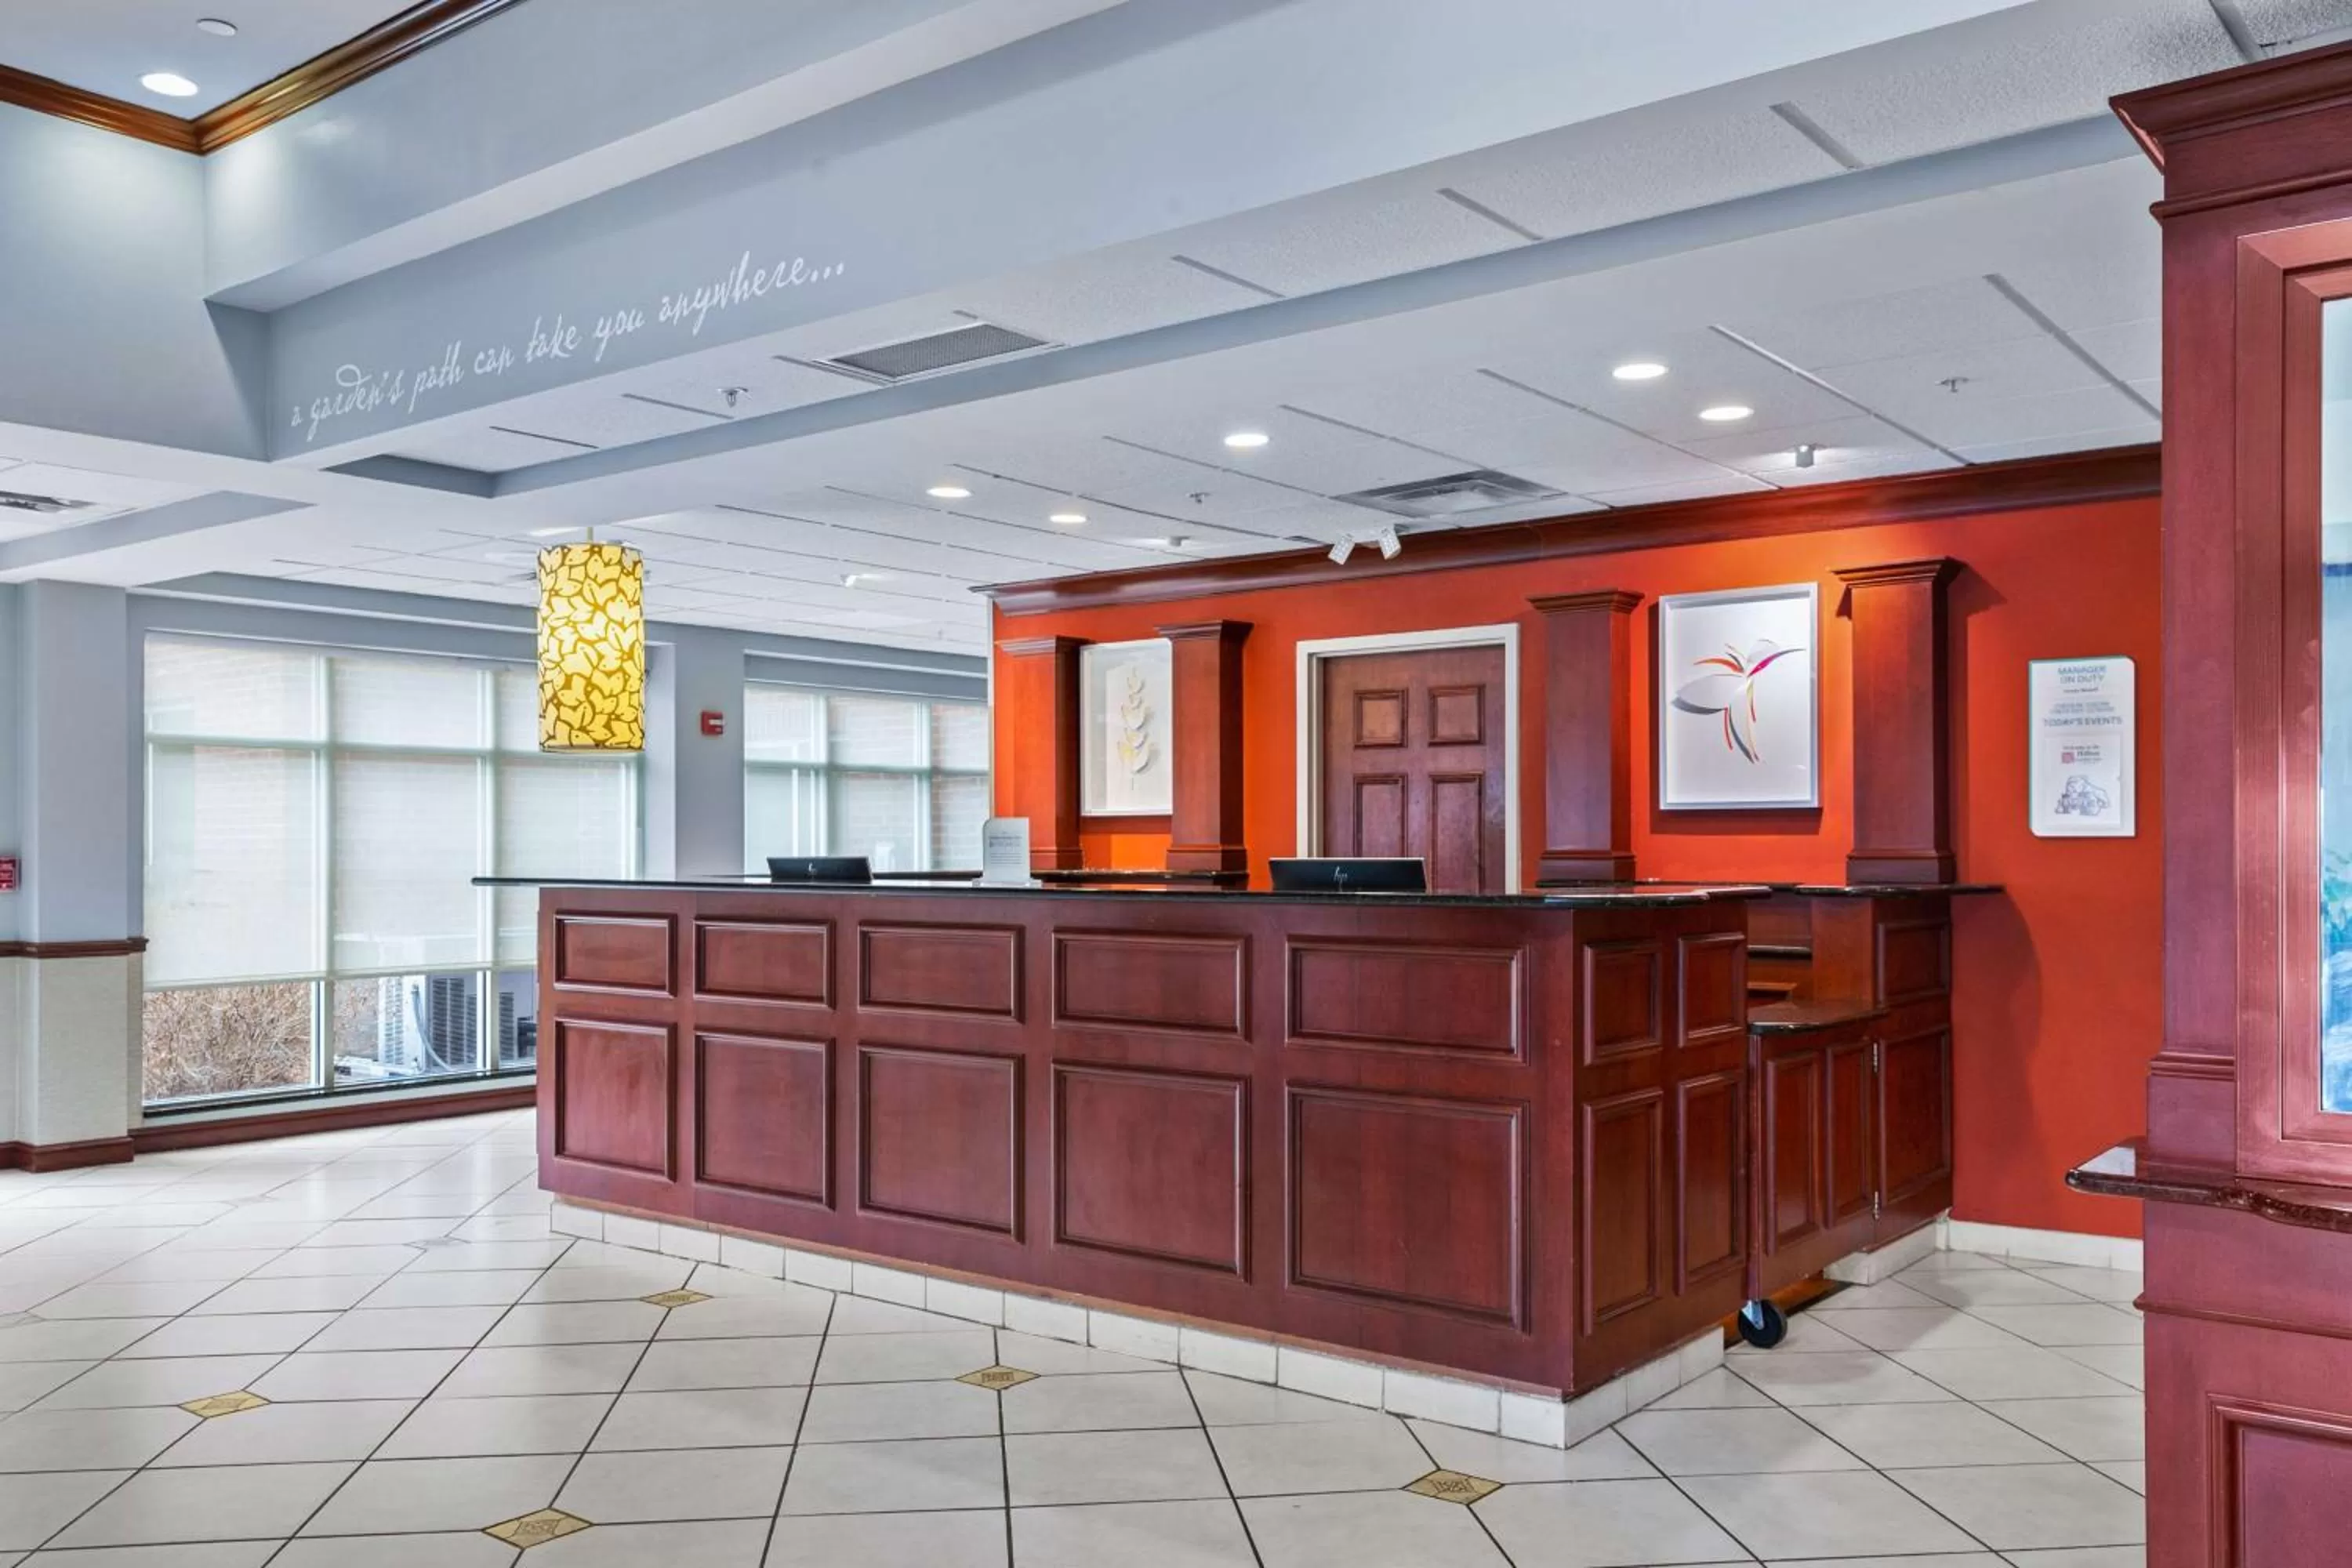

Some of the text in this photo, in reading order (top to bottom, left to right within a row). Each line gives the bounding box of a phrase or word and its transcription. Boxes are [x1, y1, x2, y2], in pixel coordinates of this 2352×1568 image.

[290, 405, 303, 426] a
[307, 363, 405, 441] garden's
[408, 339, 465, 415] path
[474, 345, 515, 376] can
[524, 313, 583, 364] take
[593, 309, 646, 363] you
